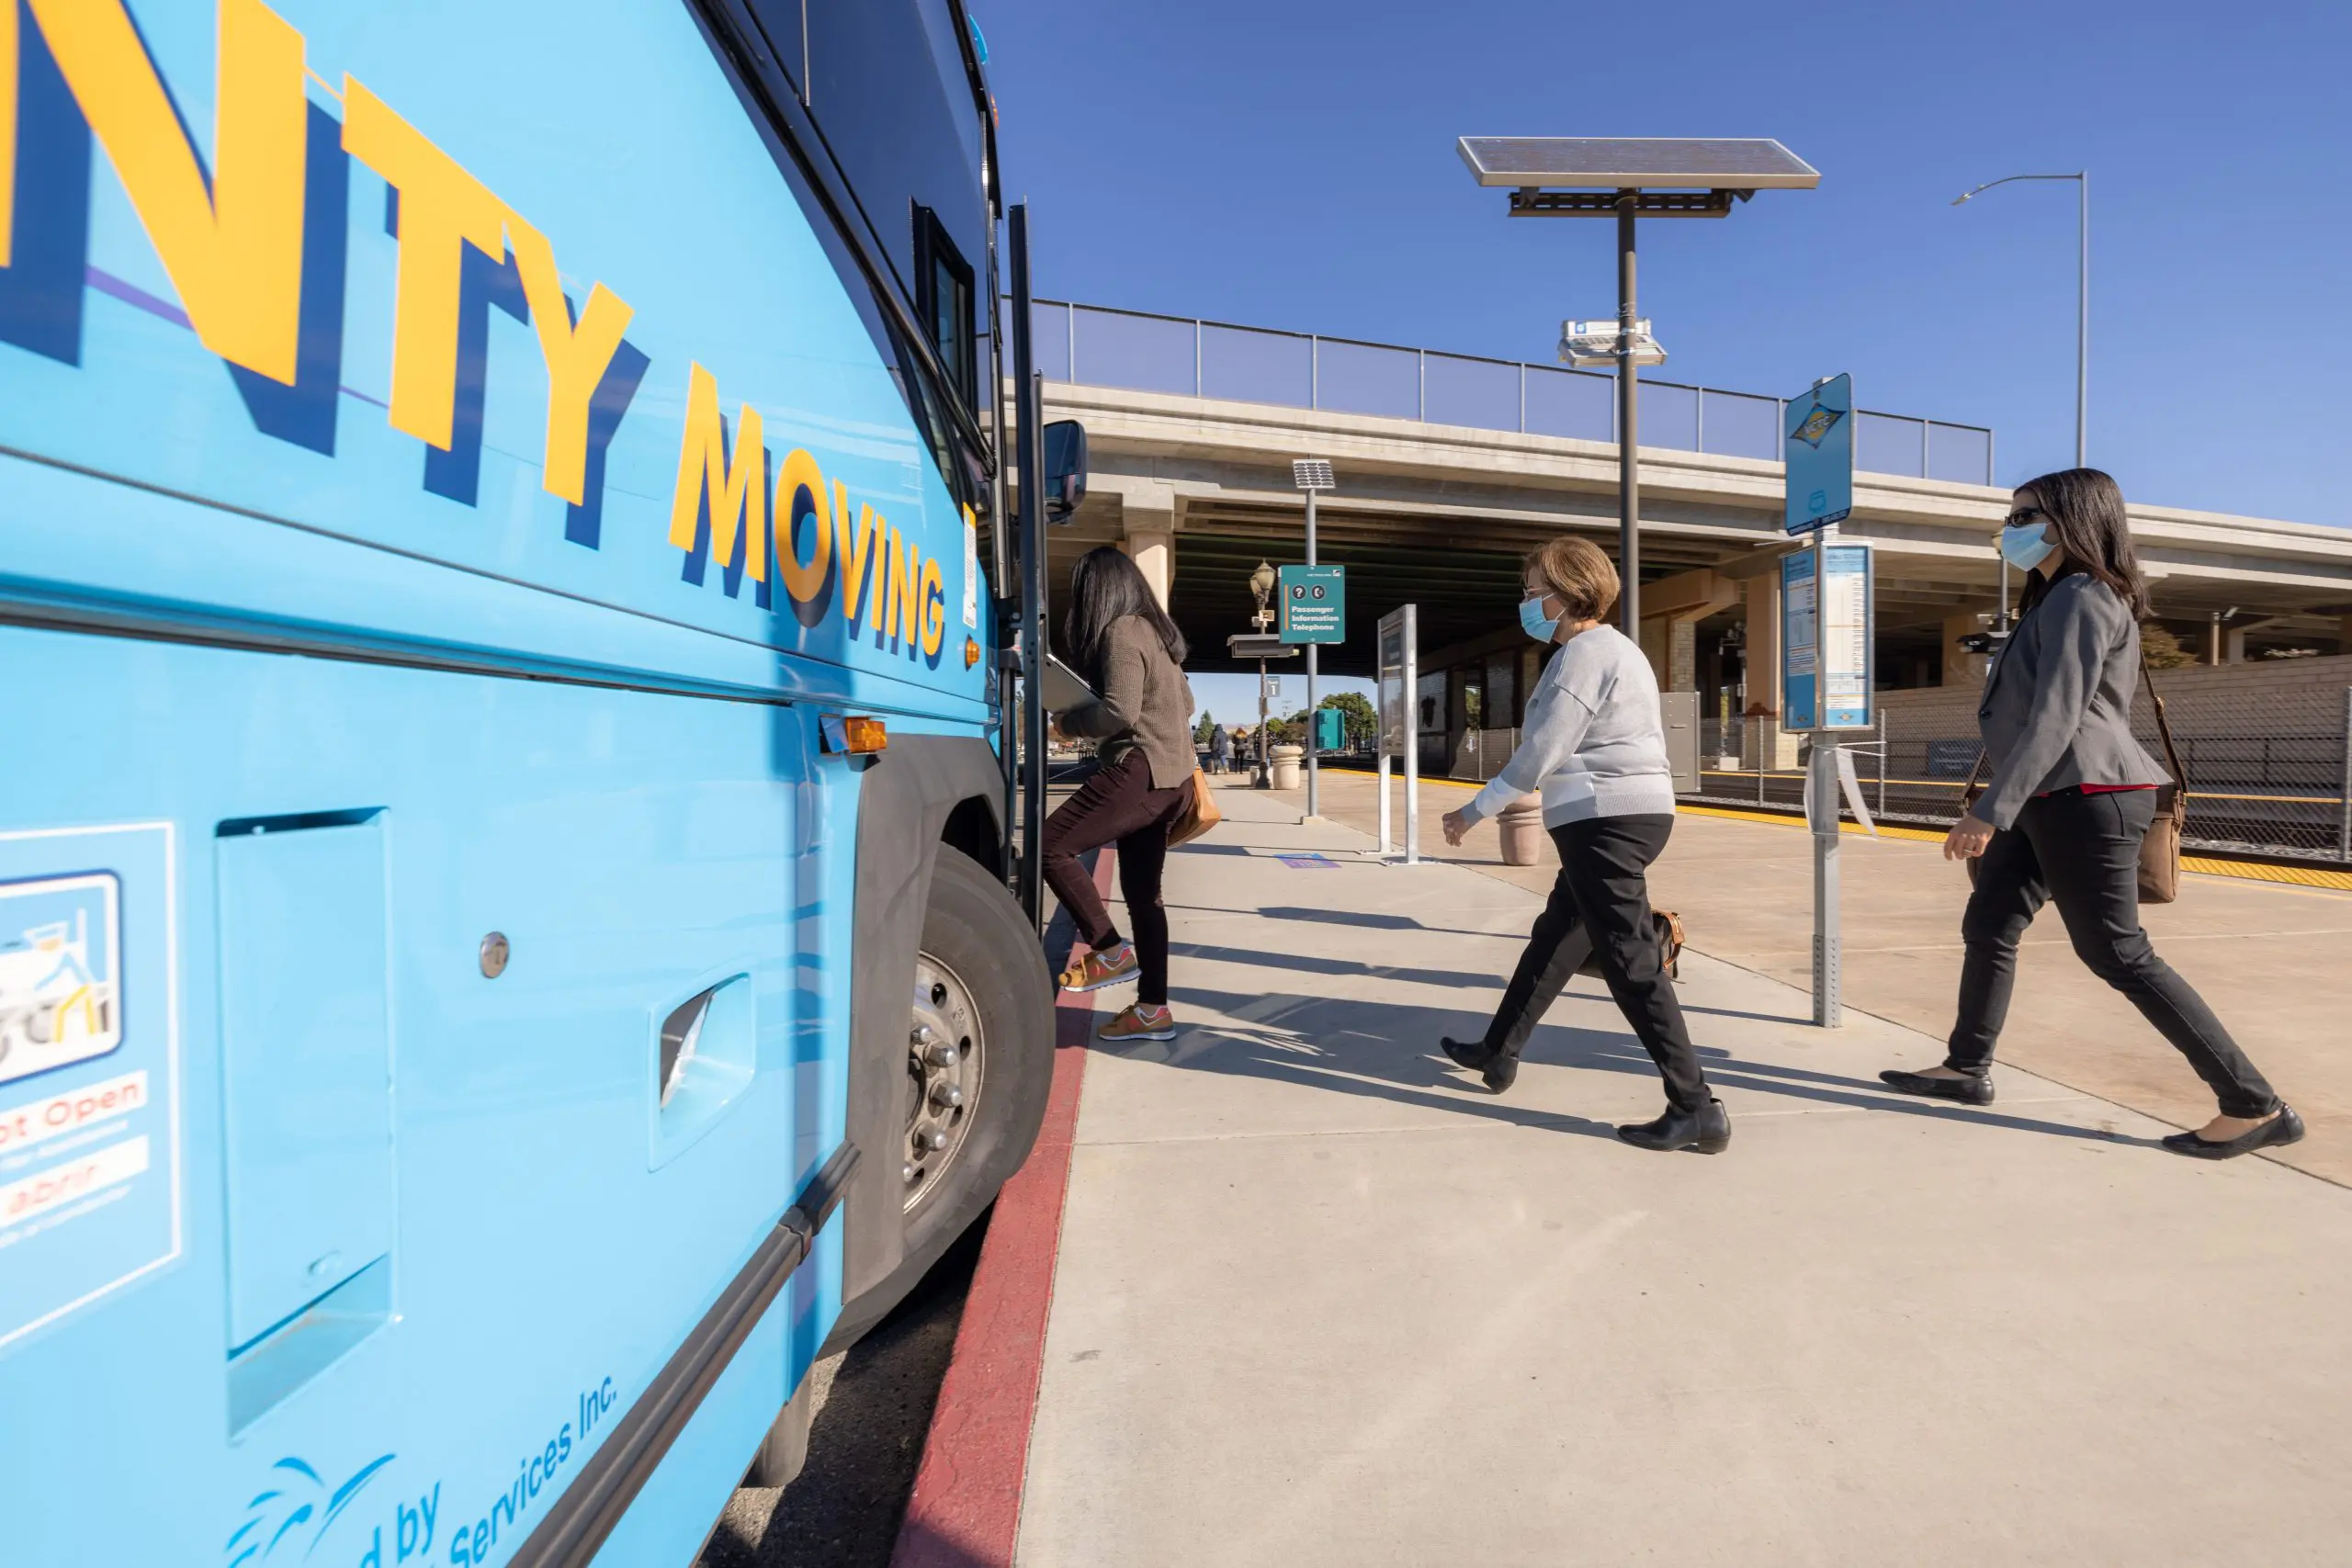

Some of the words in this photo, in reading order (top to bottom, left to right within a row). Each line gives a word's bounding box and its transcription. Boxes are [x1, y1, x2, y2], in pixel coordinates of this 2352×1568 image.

[669, 359, 944, 658] MOVING
[44, 1083, 140, 1126] Open
[579, 1376, 617, 1440] Inc.
[396, 1479, 441, 1567] by
